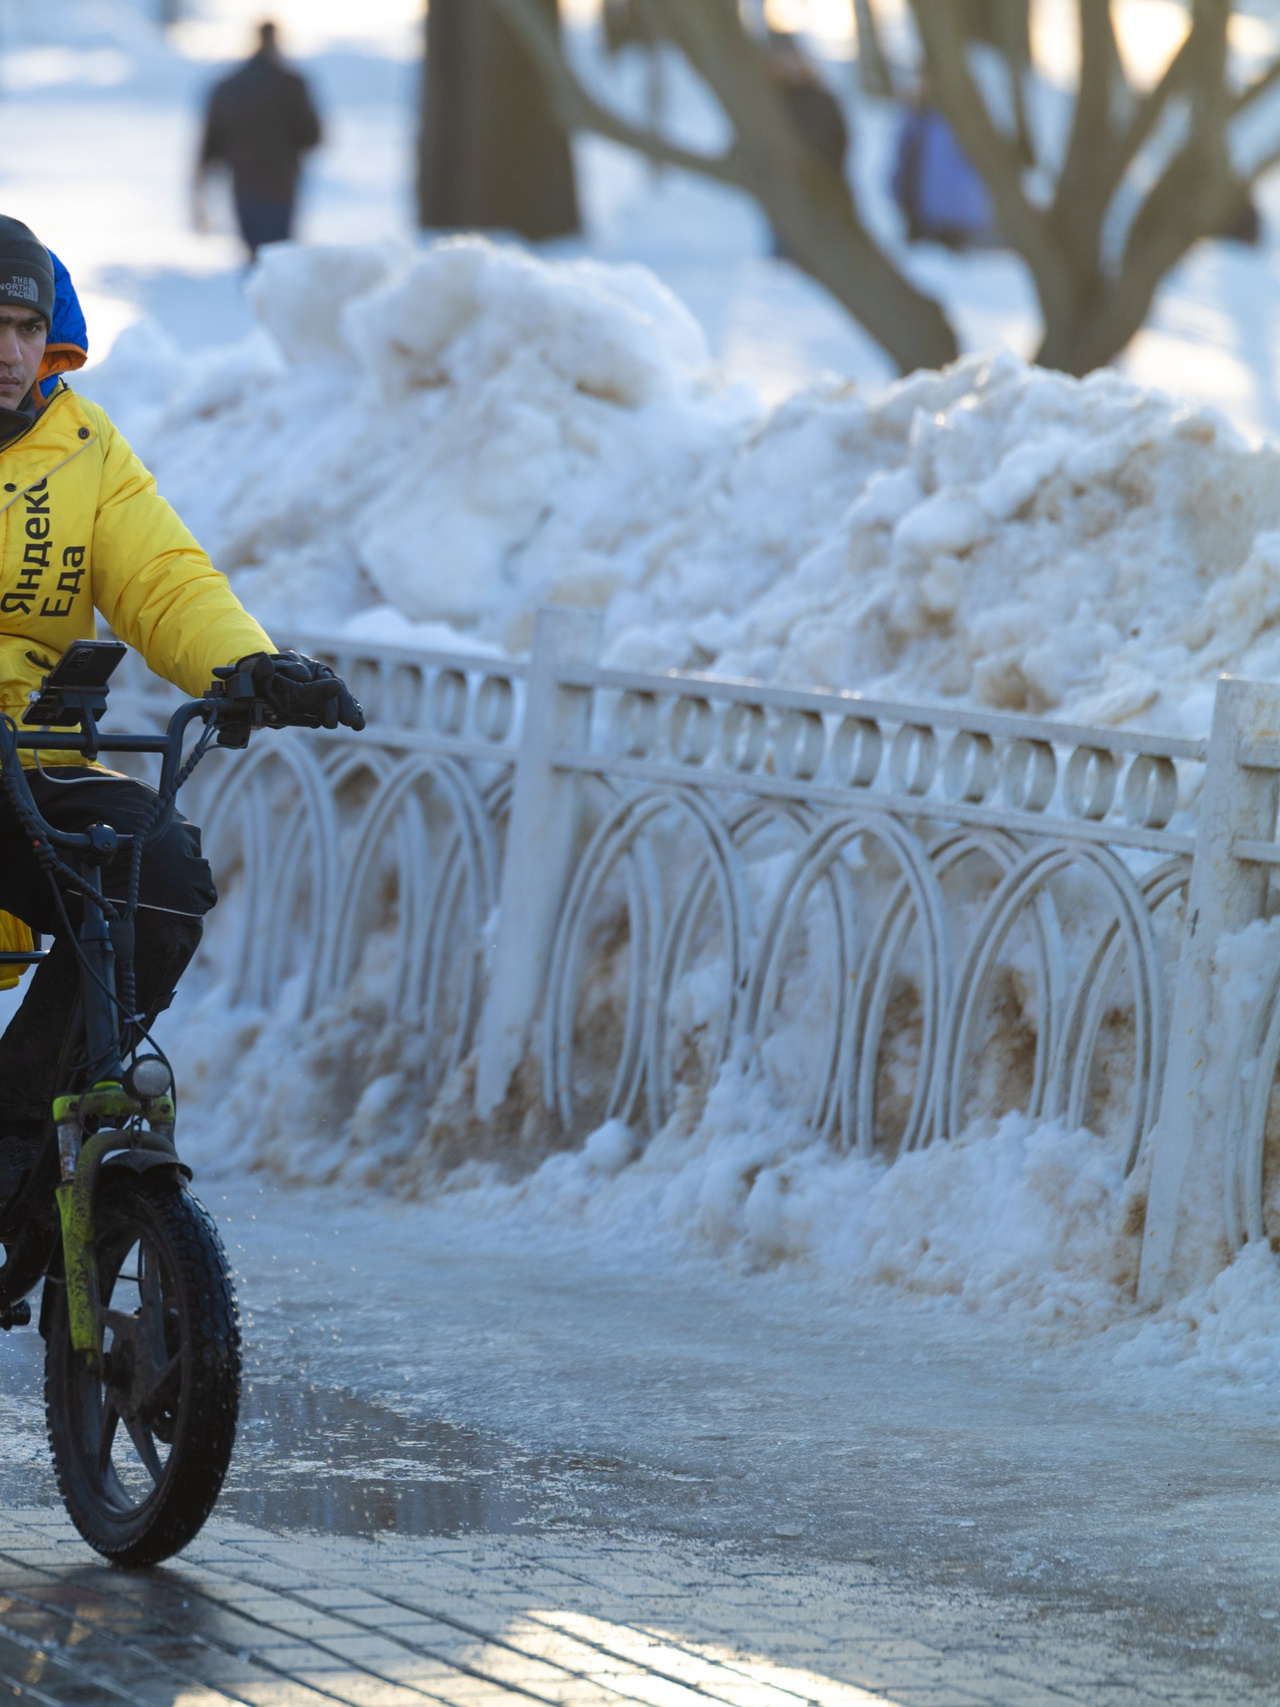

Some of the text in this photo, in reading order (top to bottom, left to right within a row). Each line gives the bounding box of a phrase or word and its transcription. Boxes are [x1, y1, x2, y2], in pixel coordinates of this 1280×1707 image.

[11, 276, 28, 284] THE
[8, 290, 29, 298] FACE
[39, 546, 86, 616] Еда
